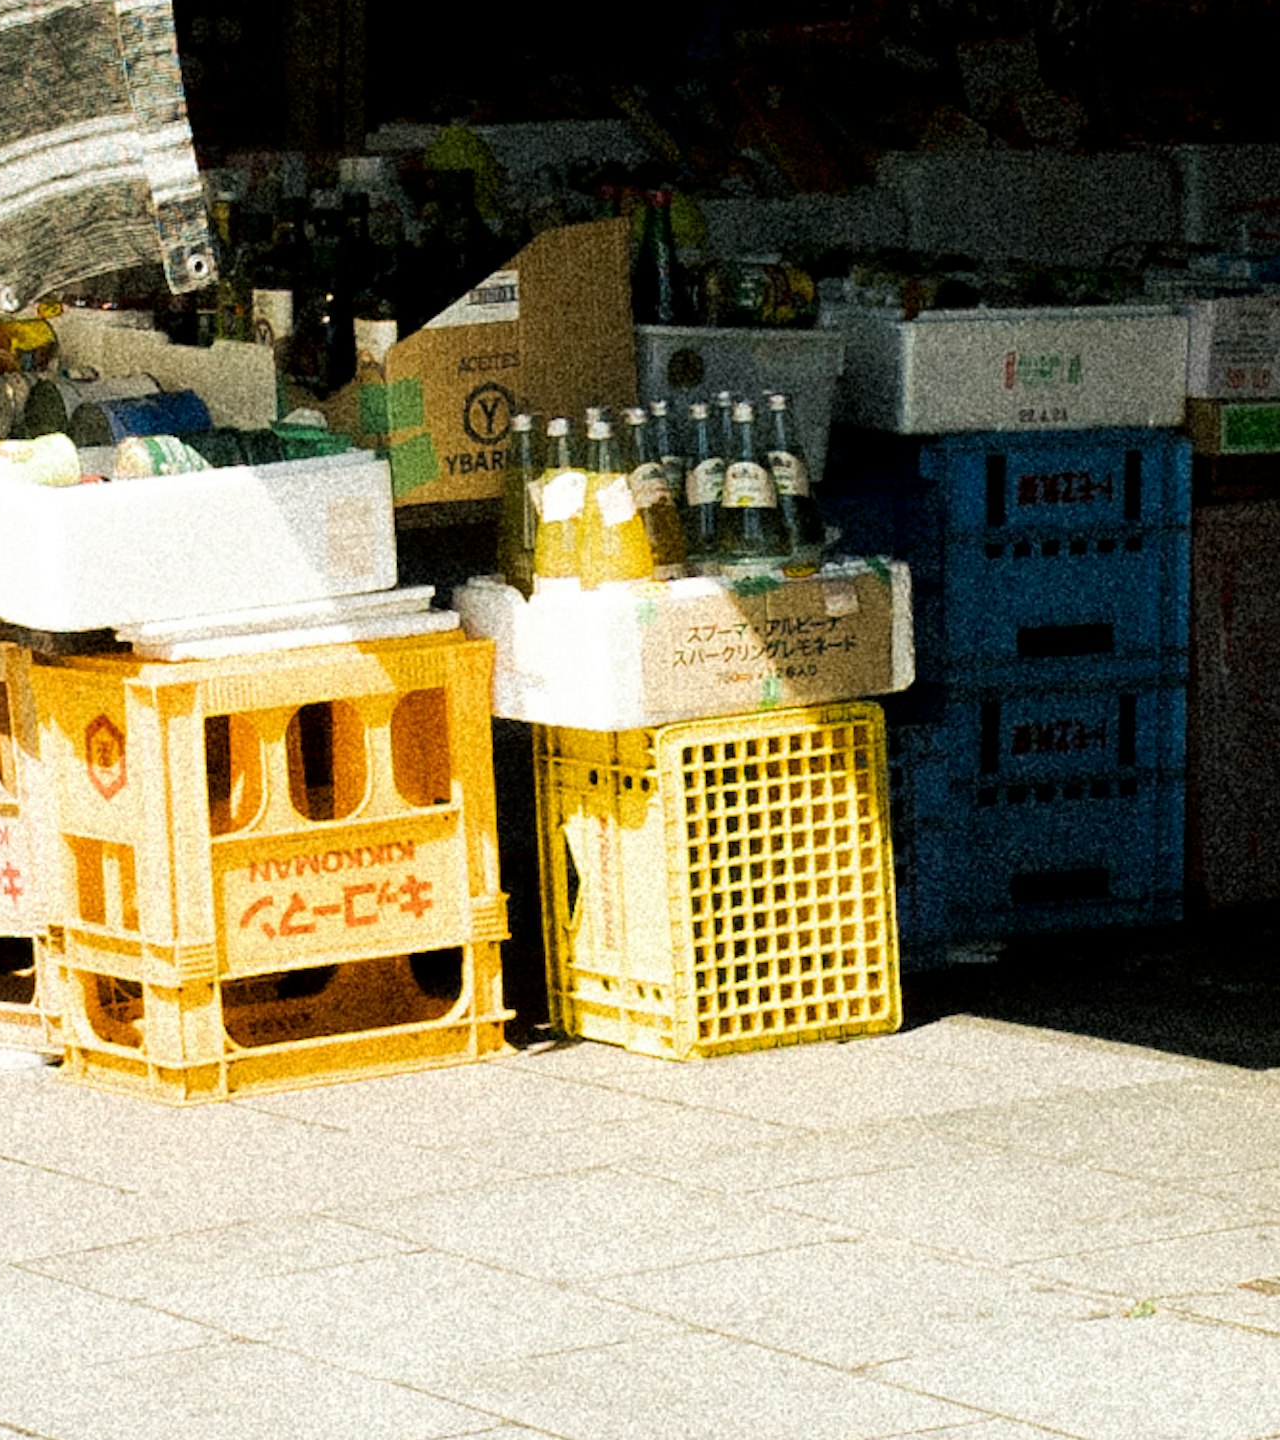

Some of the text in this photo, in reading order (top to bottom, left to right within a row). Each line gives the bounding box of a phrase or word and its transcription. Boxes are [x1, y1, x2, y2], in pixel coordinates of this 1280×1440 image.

[456, 352, 520, 377] ACEITES
[444, 450, 513, 479] YBAR
[248, 839, 416, 884] KIKKOMAN
[239, 873, 434, 940] キッコーマン
